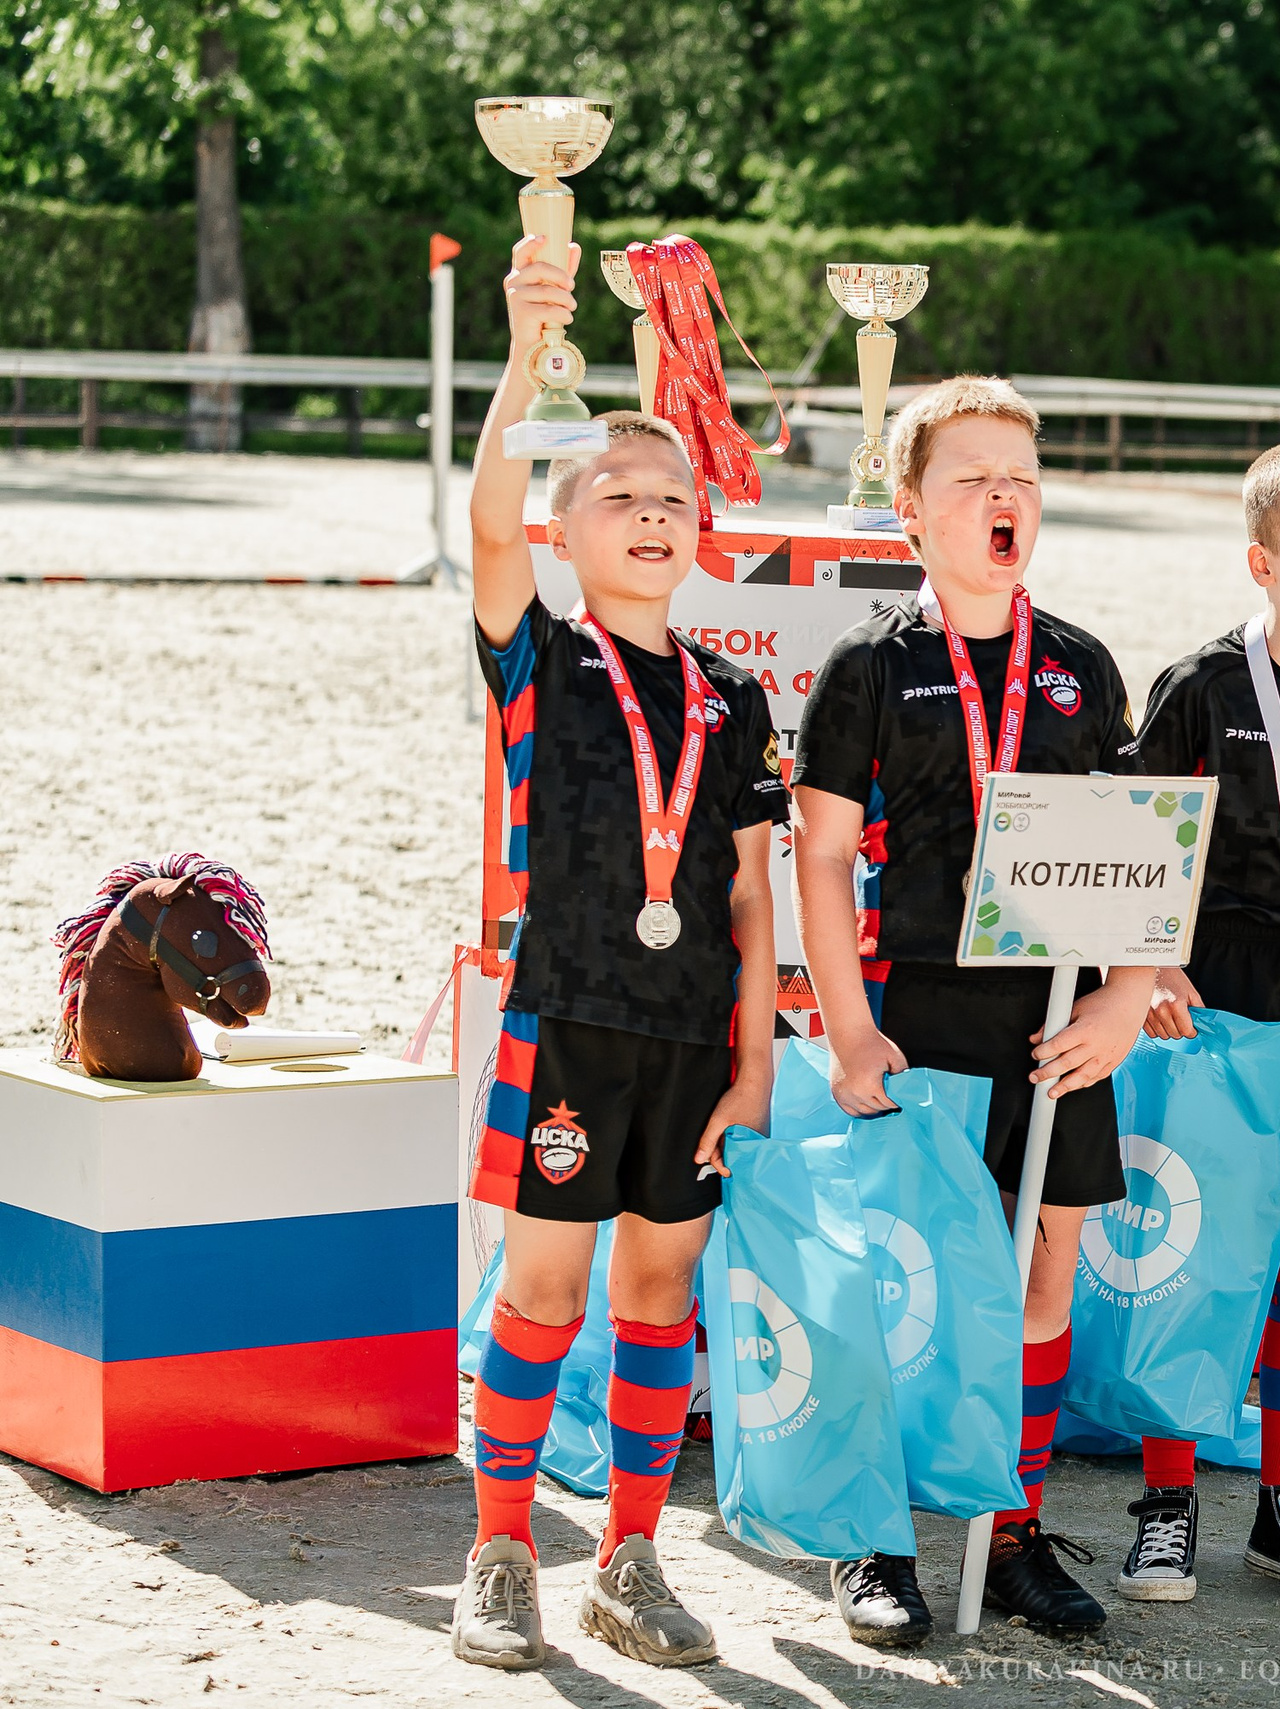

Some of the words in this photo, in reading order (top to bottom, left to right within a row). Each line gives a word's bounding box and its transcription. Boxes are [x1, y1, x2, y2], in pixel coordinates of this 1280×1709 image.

[672, 626, 779, 657] УБОК
[1013, 616, 1028, 668] МОСКОВСКИЙ
[915, 685, 960, 698] PATRIC
[1034, 672, 1082, 690] ЦСКА
[966, 701, 989, 759] МОСКОВСКИЙ
[1006, 708, 1021, 735] СПОРТ
[634, 725, 651, 752] СПОРТ
[1000, 733, 1016, 773] КОВСКИЙ
[680, 731, 701, 790] МОСКОВСКИЙ
[638, 753, 660, 813] МОСКОВСКИЙ
[672, 786, 691, 818] СПОРТ
[1010, 861, 1167, 889] КОТЛЕТКИ
[530, 1127, 590, 1152] ЦСКА
[1107, 1200, 1165, 1232] МИР
[1077, 1252, 1100, 1291] ОТРИ
[1097, 1285, 1115, 1304] НА
[1116, 1295, 1130, 1309] 18
[1132, 1270, 1191, 1309] КНОПКЕ
[734, 1336, 775, 1362] ИР
[758, 1429, 777, 1444] 18
[778, 1394, 820, 1439] КНОПКЕ
